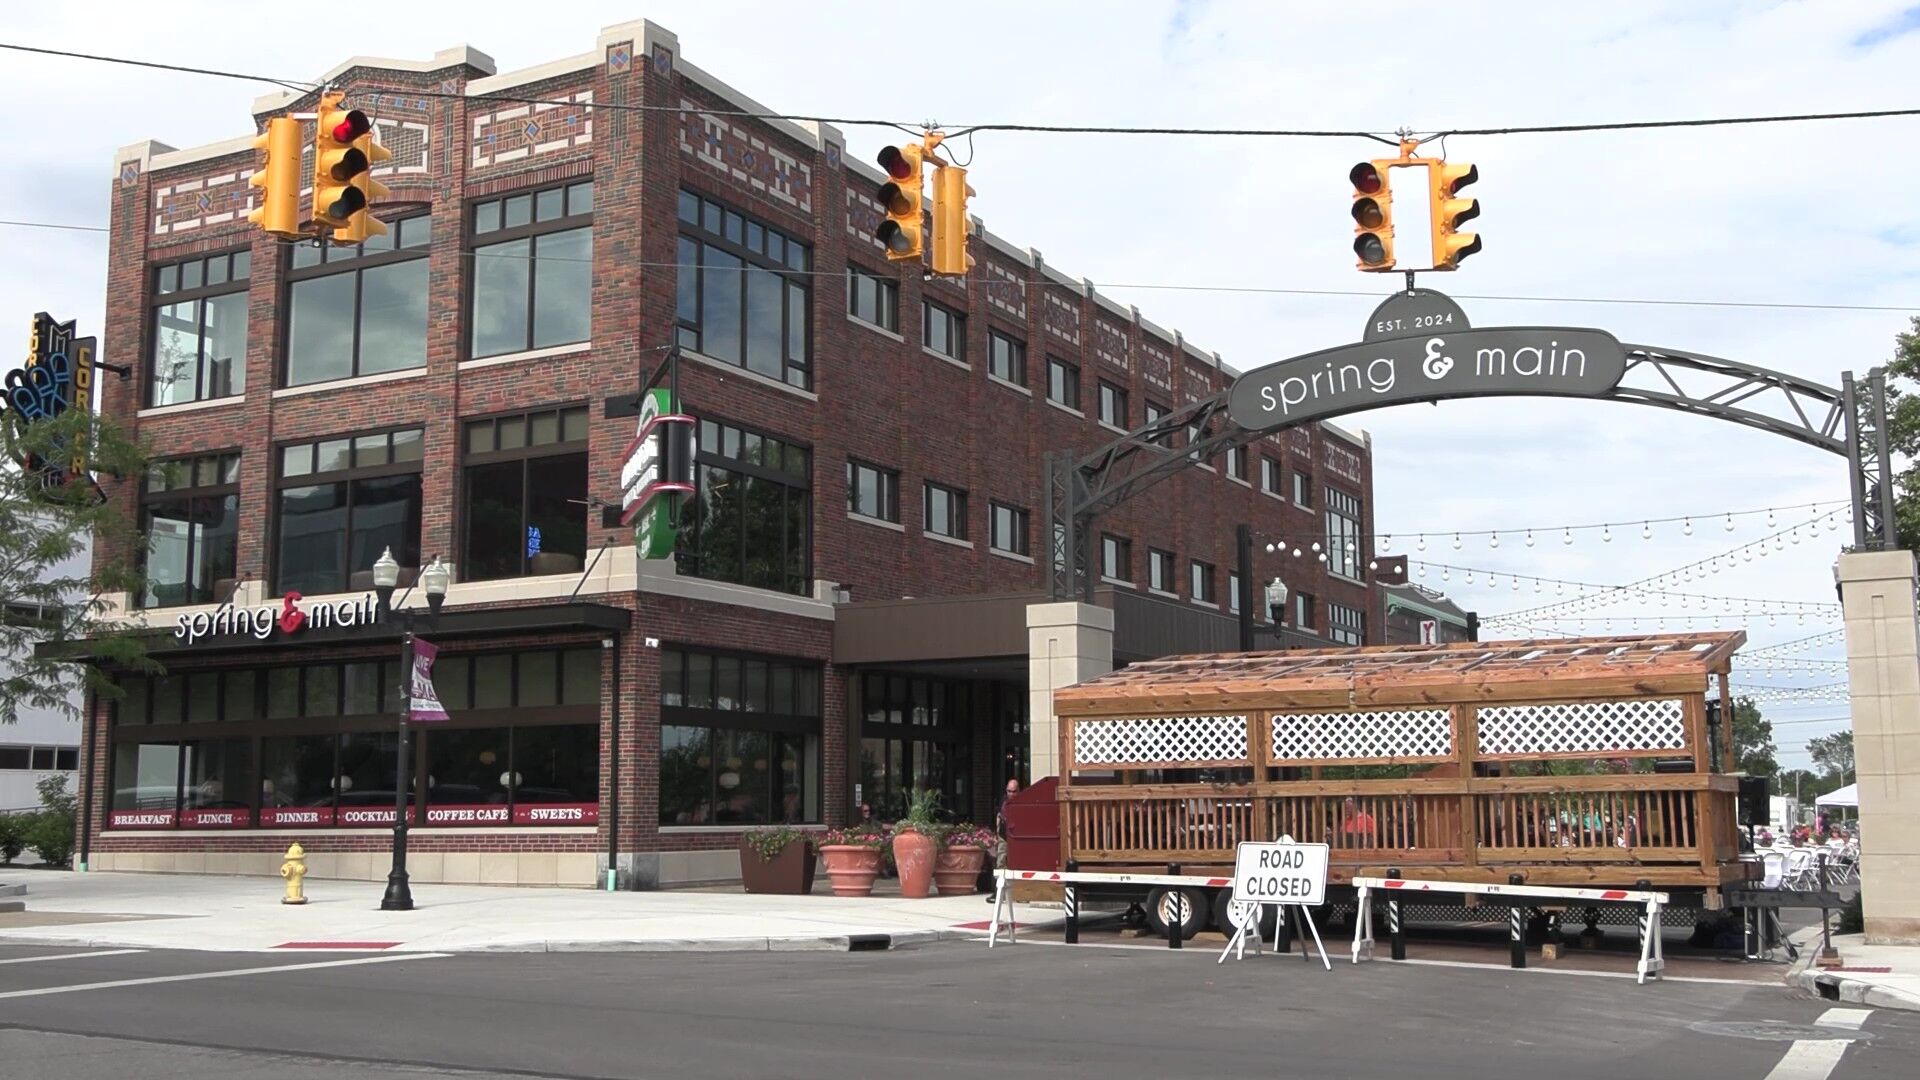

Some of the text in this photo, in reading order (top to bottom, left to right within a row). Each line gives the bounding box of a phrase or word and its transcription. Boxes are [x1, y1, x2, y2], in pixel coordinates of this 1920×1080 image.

[1377, 313, 1453, 333] EST. 2024
[1260, 337, 1587, 415] spring & main
[174, 604, 274, 645] spring
[279, 591, 306, 635] &
[114, 814, 172, 825] BREAKFAST
[197, 813, 233, 824] LUNCH
[275, 812, 319, 823] DINNER
[345, 810, 409, 822] COCKTAI
[427, 807, 509, 821] COFFEE CAFÉ
[530, 808, 583, 820] SWEETS
[1259, 849, 1304, 869] ROAD
[1246, 876, 1312, 897] CLOSED
